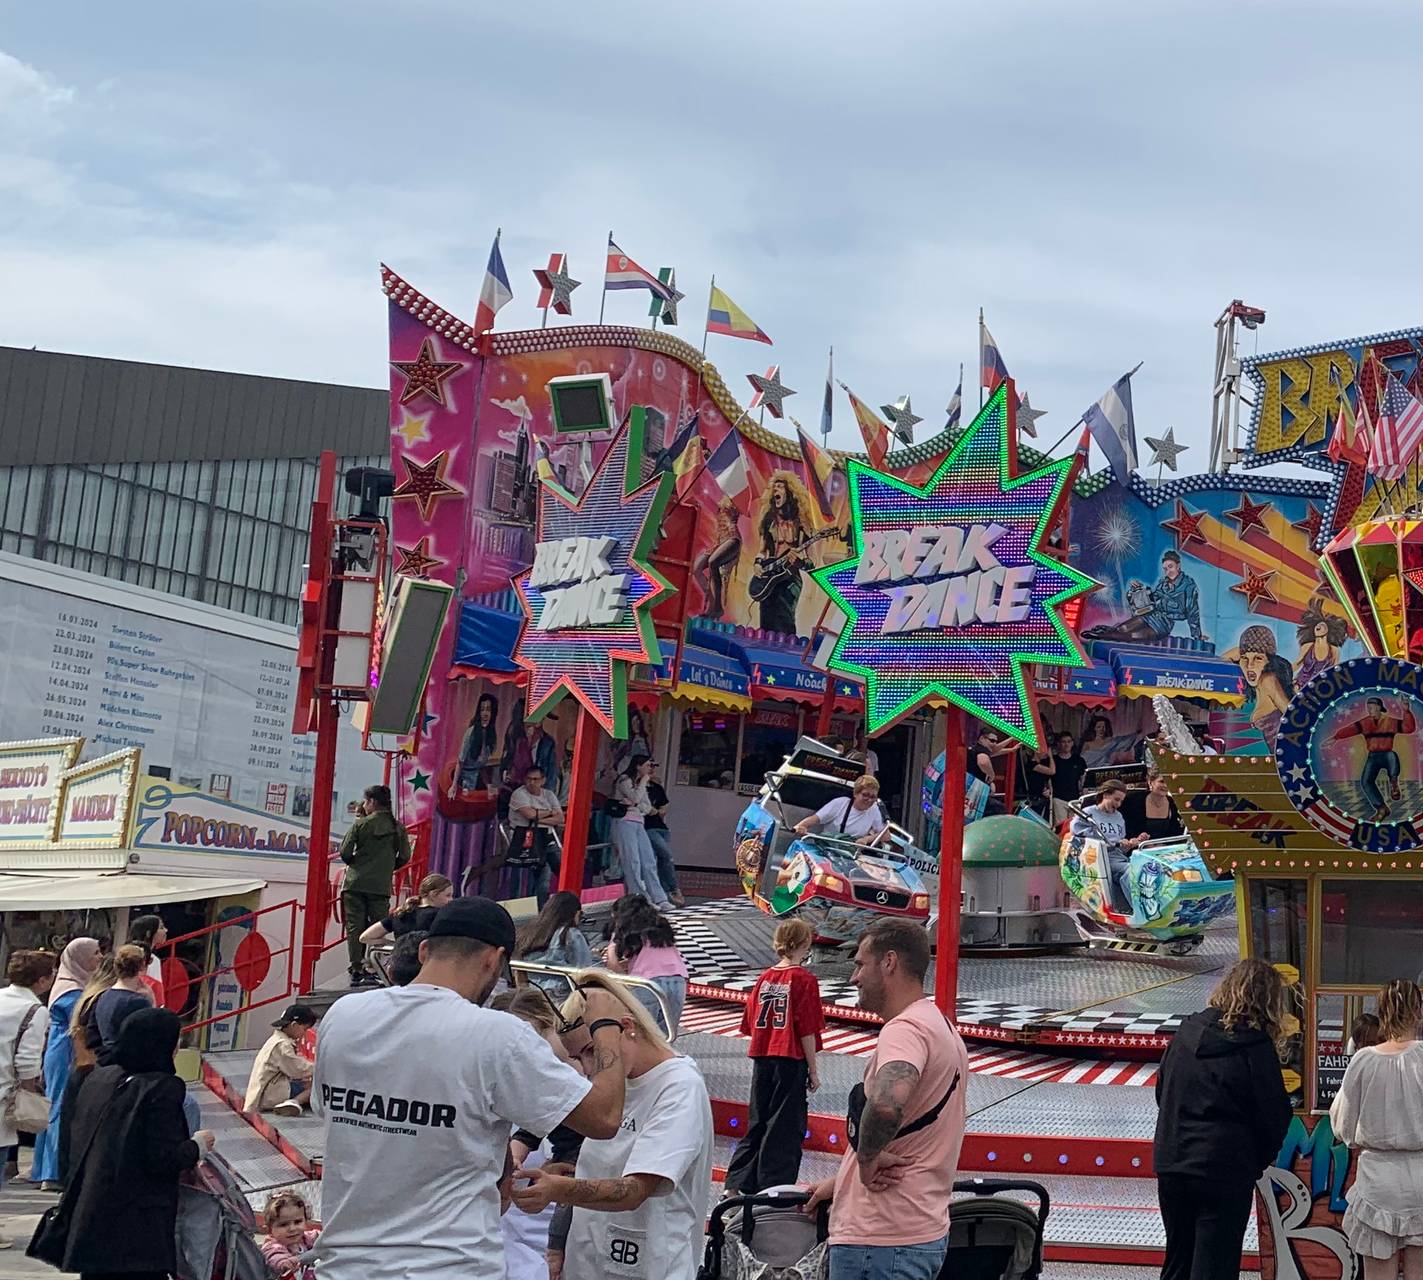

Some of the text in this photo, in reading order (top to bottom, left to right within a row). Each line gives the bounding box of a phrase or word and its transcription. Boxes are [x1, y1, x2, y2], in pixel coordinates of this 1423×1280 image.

[530, 535, 617, 588] BREAK
[854, 523, 1009, 586] BREAK
[536, 573, 634, 632] DANCE
[880, 564, 1038, 635] DANCE
[1284, 669, 1354, 747] ACTION
[161, 811, 257, 850] POPCORN
[1357, 826, 1417, 845] USA
[755, 993, 788, 1029] 79
[321, 1083, 457, 1128] PEGADOR
[382, 1126, 417, 1137] STREETWEAR
